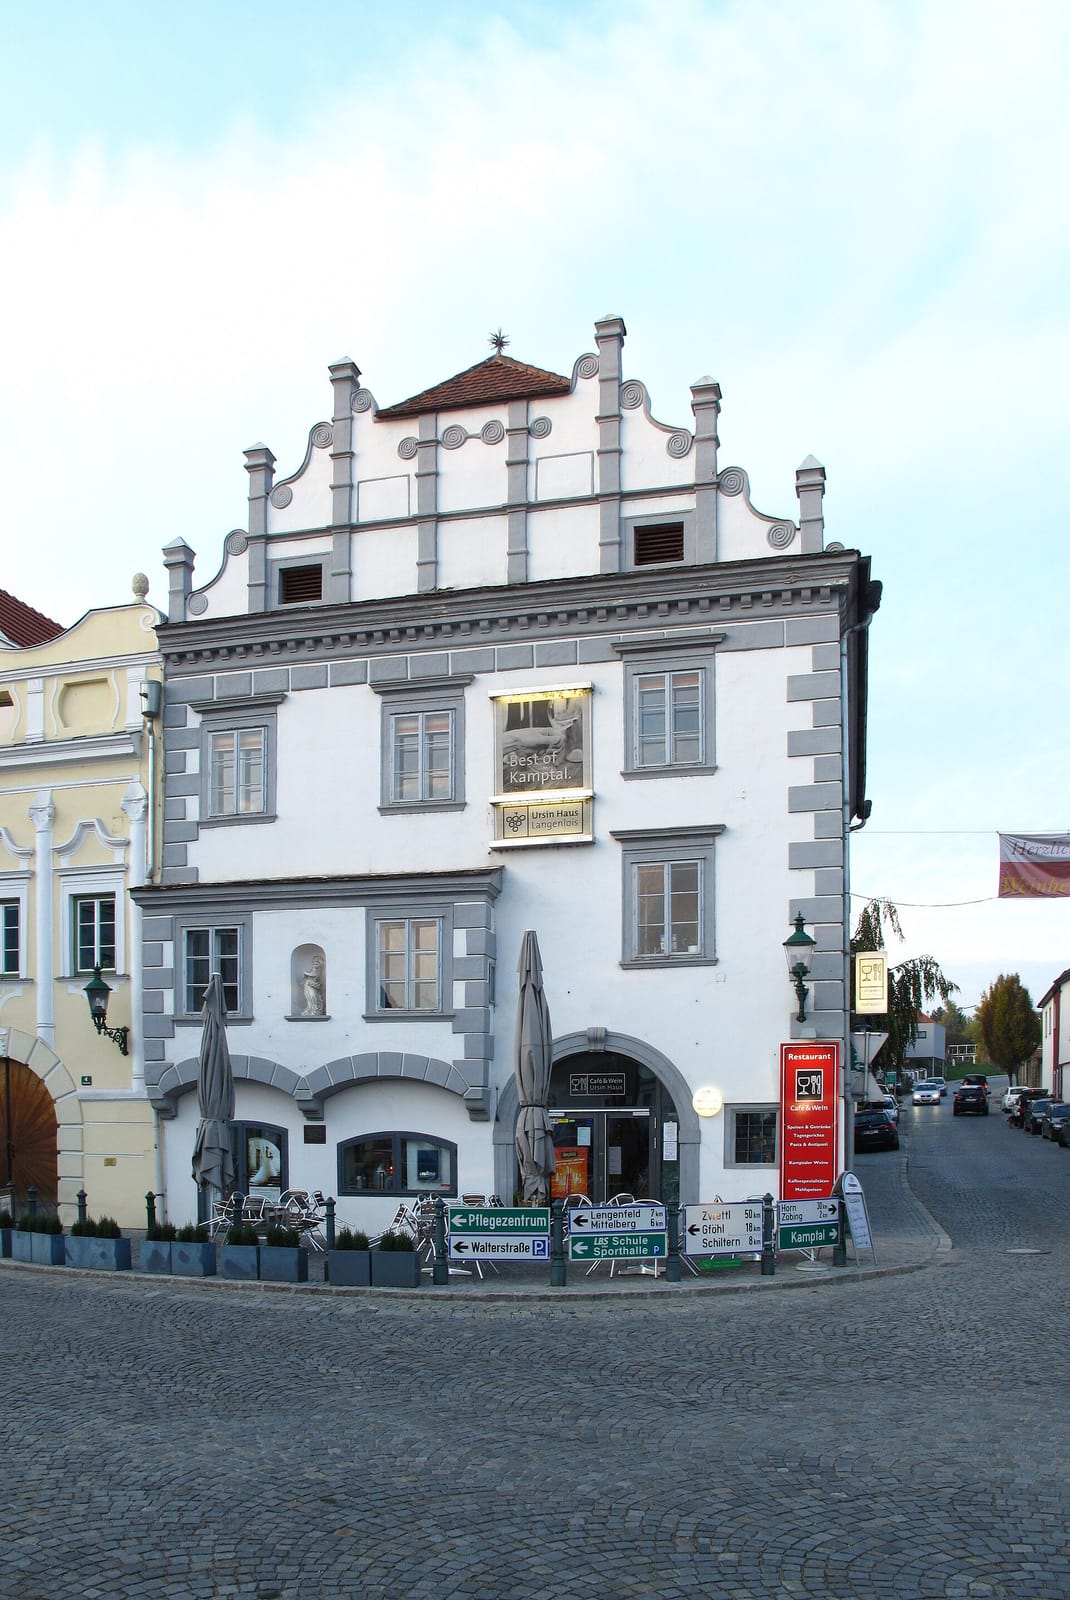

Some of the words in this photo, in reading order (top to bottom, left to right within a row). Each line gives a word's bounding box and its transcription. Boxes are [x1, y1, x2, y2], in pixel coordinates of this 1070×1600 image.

[510, 753, 538, 767] Best
[543, 750, 558, 764] of
[510, 766, 572, 785] Kamptal.
[532, 811, 554, 819] Ursin
[557, 810, 579, 818] Haus
[532, 819, 579, 830] Langenlois
[1011, 841, 1070, 855] Herzlic
[781, 1203, 797, 1212] Horn
[590, 1208, 641, 1220] Lengenfeld
[650, 1208, 655, 1217] 7
[702, 1210, 731, 1220] Zwettl
[744, 1209, 753, 1219] 50
[468, 1213, 547, 1230] Pflegezentrum
[591, 1220, 637, 1230] Mittelberg
[650, 1218, 655, 1227] 6
[655, 1219, 664, 1227] km
[702, 1224, 725, 1234] Gföhl
[745, 1222, 753, 1232] 18
[612, 1236, 648, 1245] Schule
[702, 1238, 741, 1248] Schiltern
[748, 1236, 753, 1245] 8
[791, 1228, 825, 1244] Kamptal
[471, 1241, 530, 1253] Walterstraße
[534, 1240, 544, 1255] P
[593, 1246, 648, 1257] Sporthalle
[653, 1245, 660, 1254] P
